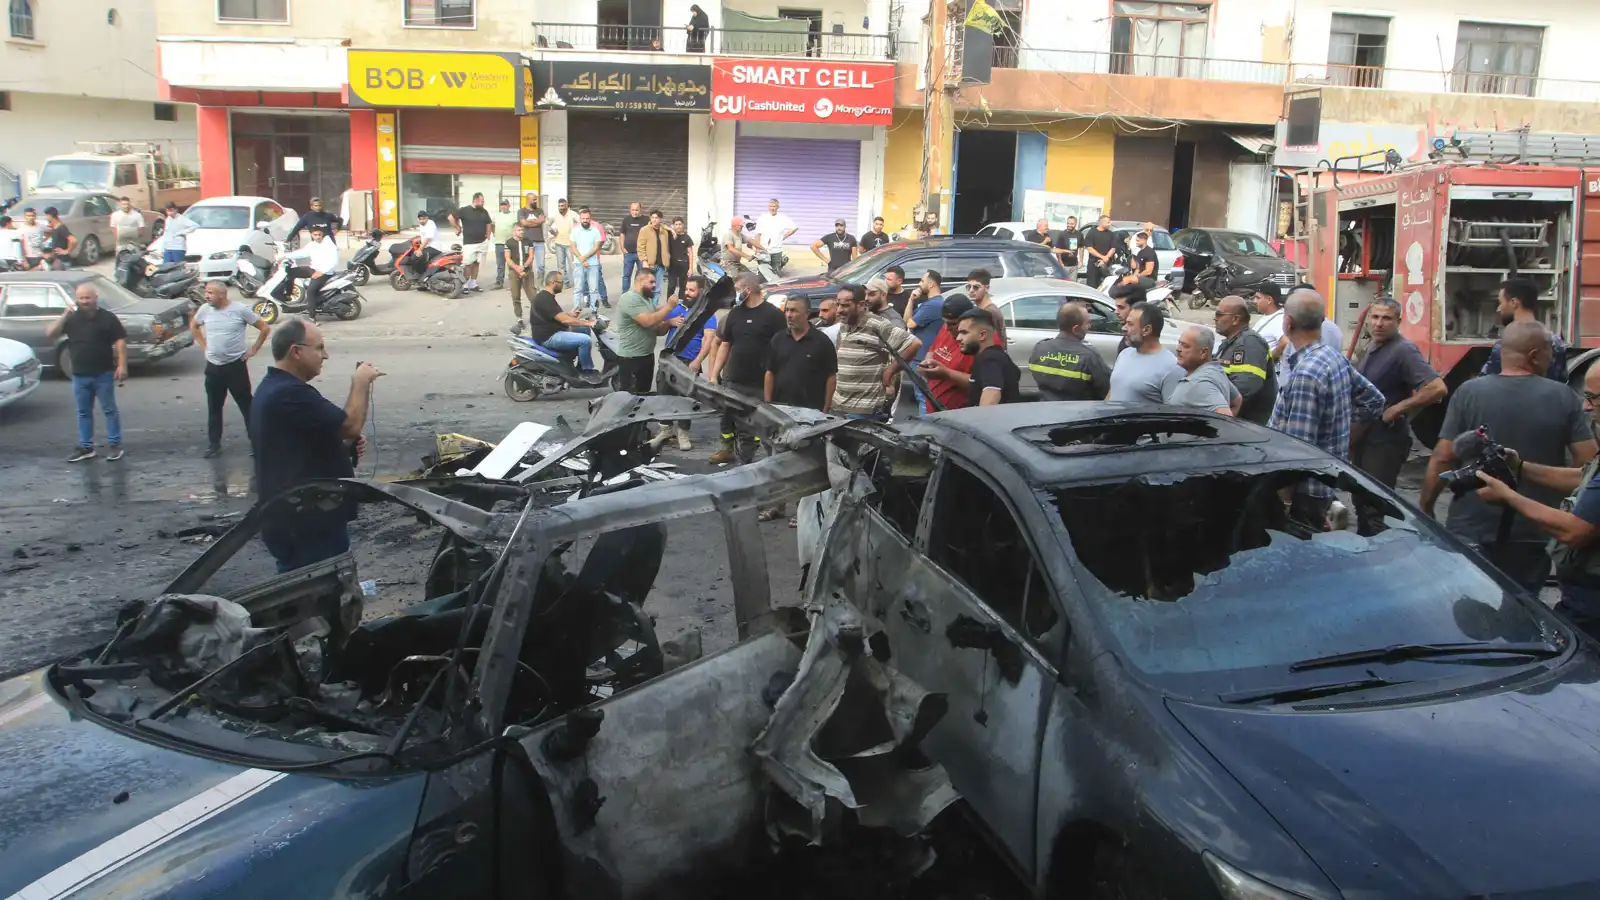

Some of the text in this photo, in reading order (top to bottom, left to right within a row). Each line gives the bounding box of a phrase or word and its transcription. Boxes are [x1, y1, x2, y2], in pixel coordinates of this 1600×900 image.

[470, 72, 509, 82] Western
[470, 82, 498, 90] Union
[560, 72, 632, 95] الكواكب
[635, 74, 707, 98] مجوهرات
[732, 65, 875, 89] SMART CELL
[713, 95, 743, 114] CU
[747, 100, 805, 113] CashUnited
[1402, 187, 1432, 207] الدفاع
[1040, 351, 1080, 366] الدفاع المدني
